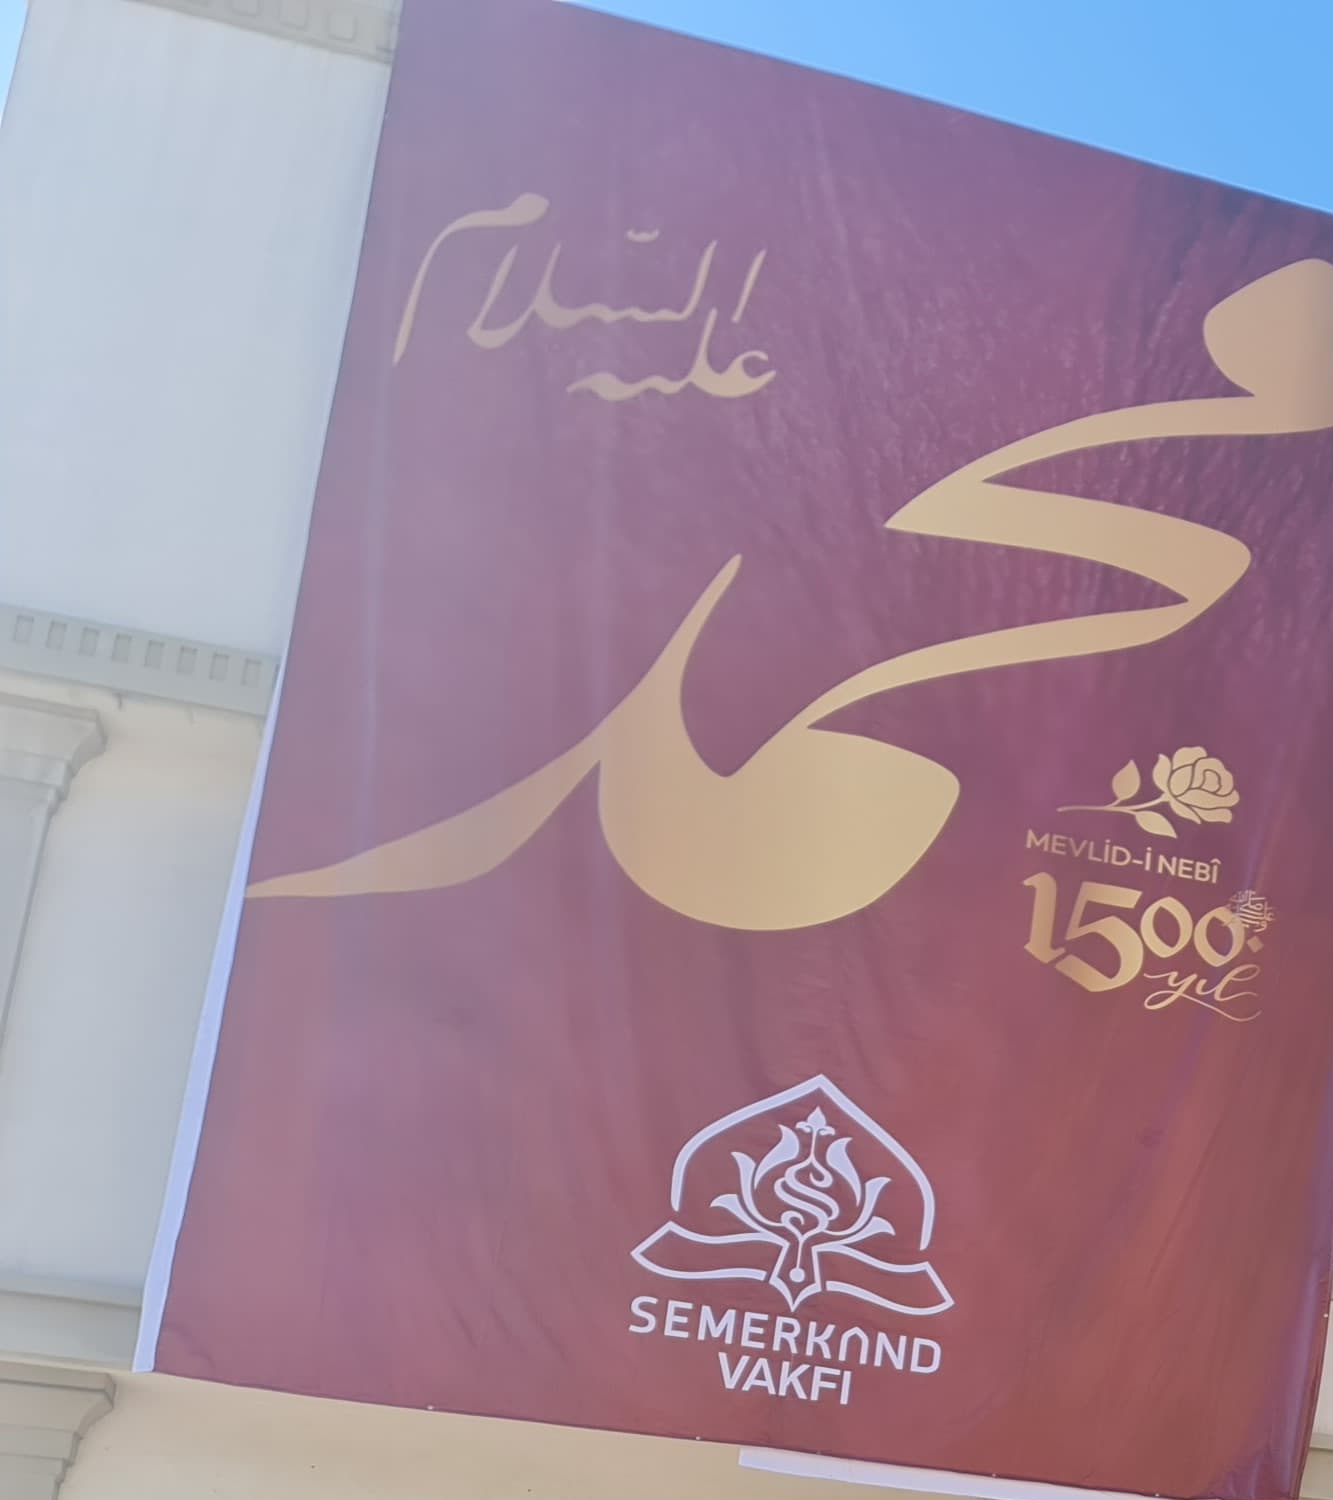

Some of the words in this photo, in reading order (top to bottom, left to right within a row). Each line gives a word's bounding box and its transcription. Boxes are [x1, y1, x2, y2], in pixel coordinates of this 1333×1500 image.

[1157, 854, 1222, 884] NEBÎ
[1022, 871, 1246, 993] 1500
[628, 1295, 942, 1375] SEMERKAND
[717, 1350, 853, 1405] VAKFI
